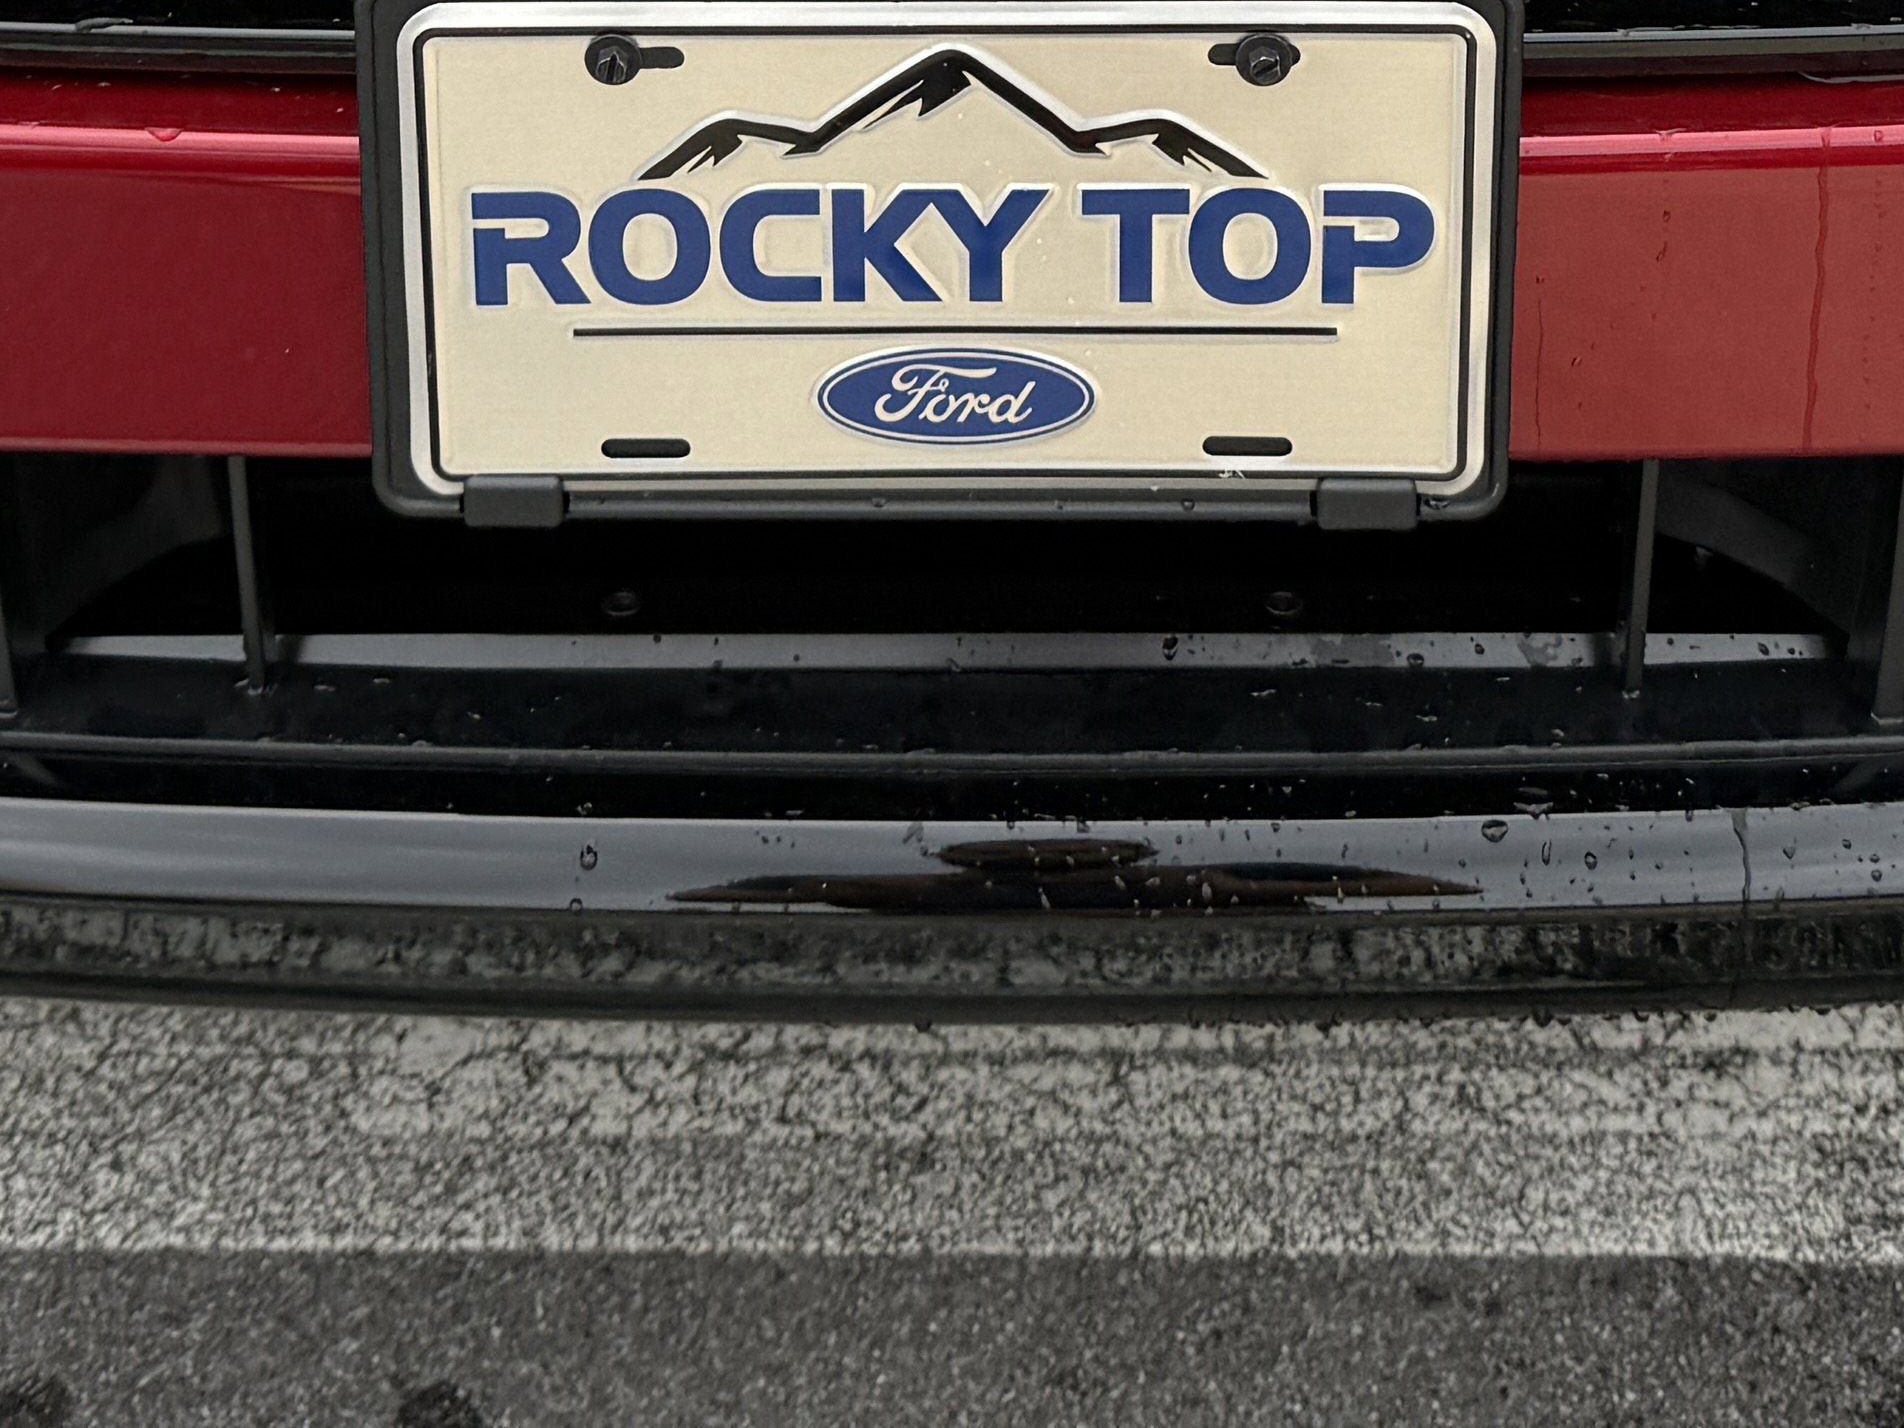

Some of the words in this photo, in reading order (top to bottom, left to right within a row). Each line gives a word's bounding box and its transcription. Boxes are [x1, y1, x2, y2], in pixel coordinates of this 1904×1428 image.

[470, 186, 1052, 308] ROCKY
[1081, 185, 1437, 307] TOP
[872, 362, 1034, 428] Ford
